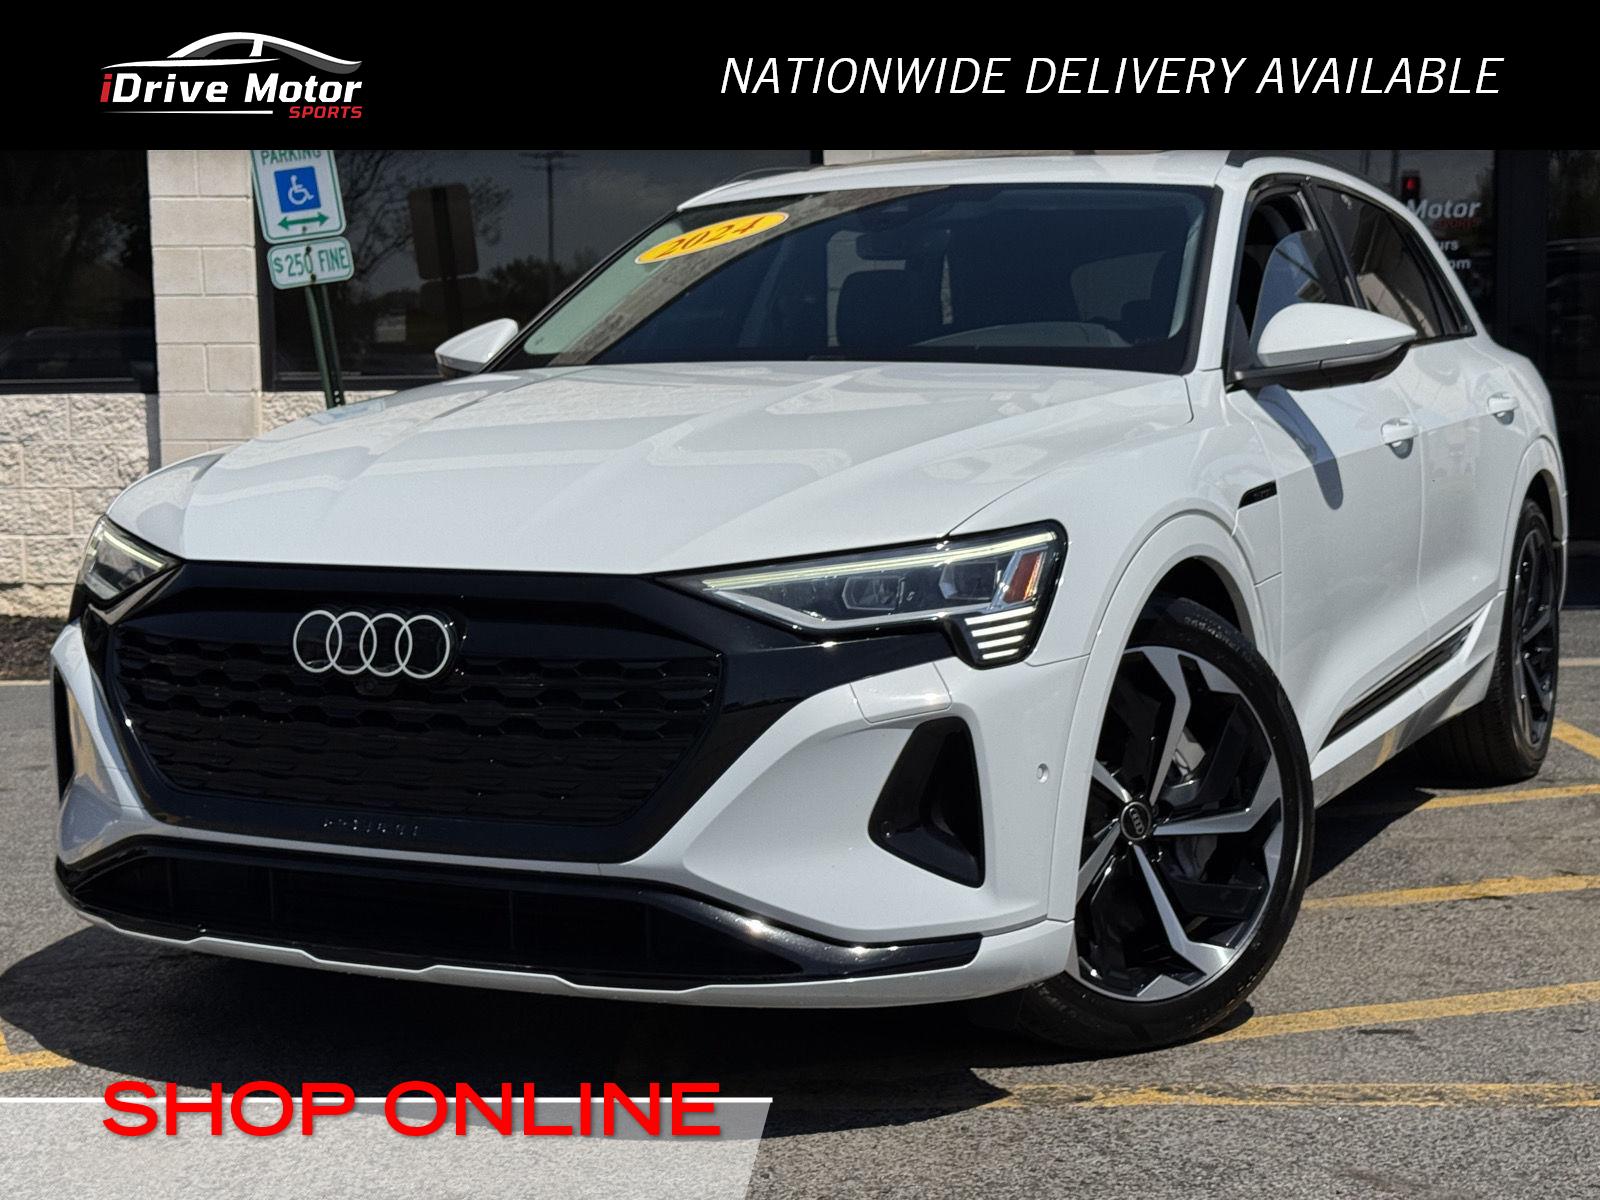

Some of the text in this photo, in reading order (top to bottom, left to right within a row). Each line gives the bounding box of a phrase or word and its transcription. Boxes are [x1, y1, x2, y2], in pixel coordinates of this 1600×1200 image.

[260, 150, 322, 165] PARKING
[1406, 198, 1481, 219] Motor
[655, 216, 765, 259] 2024
[318, 247, 350, 272] FINE
